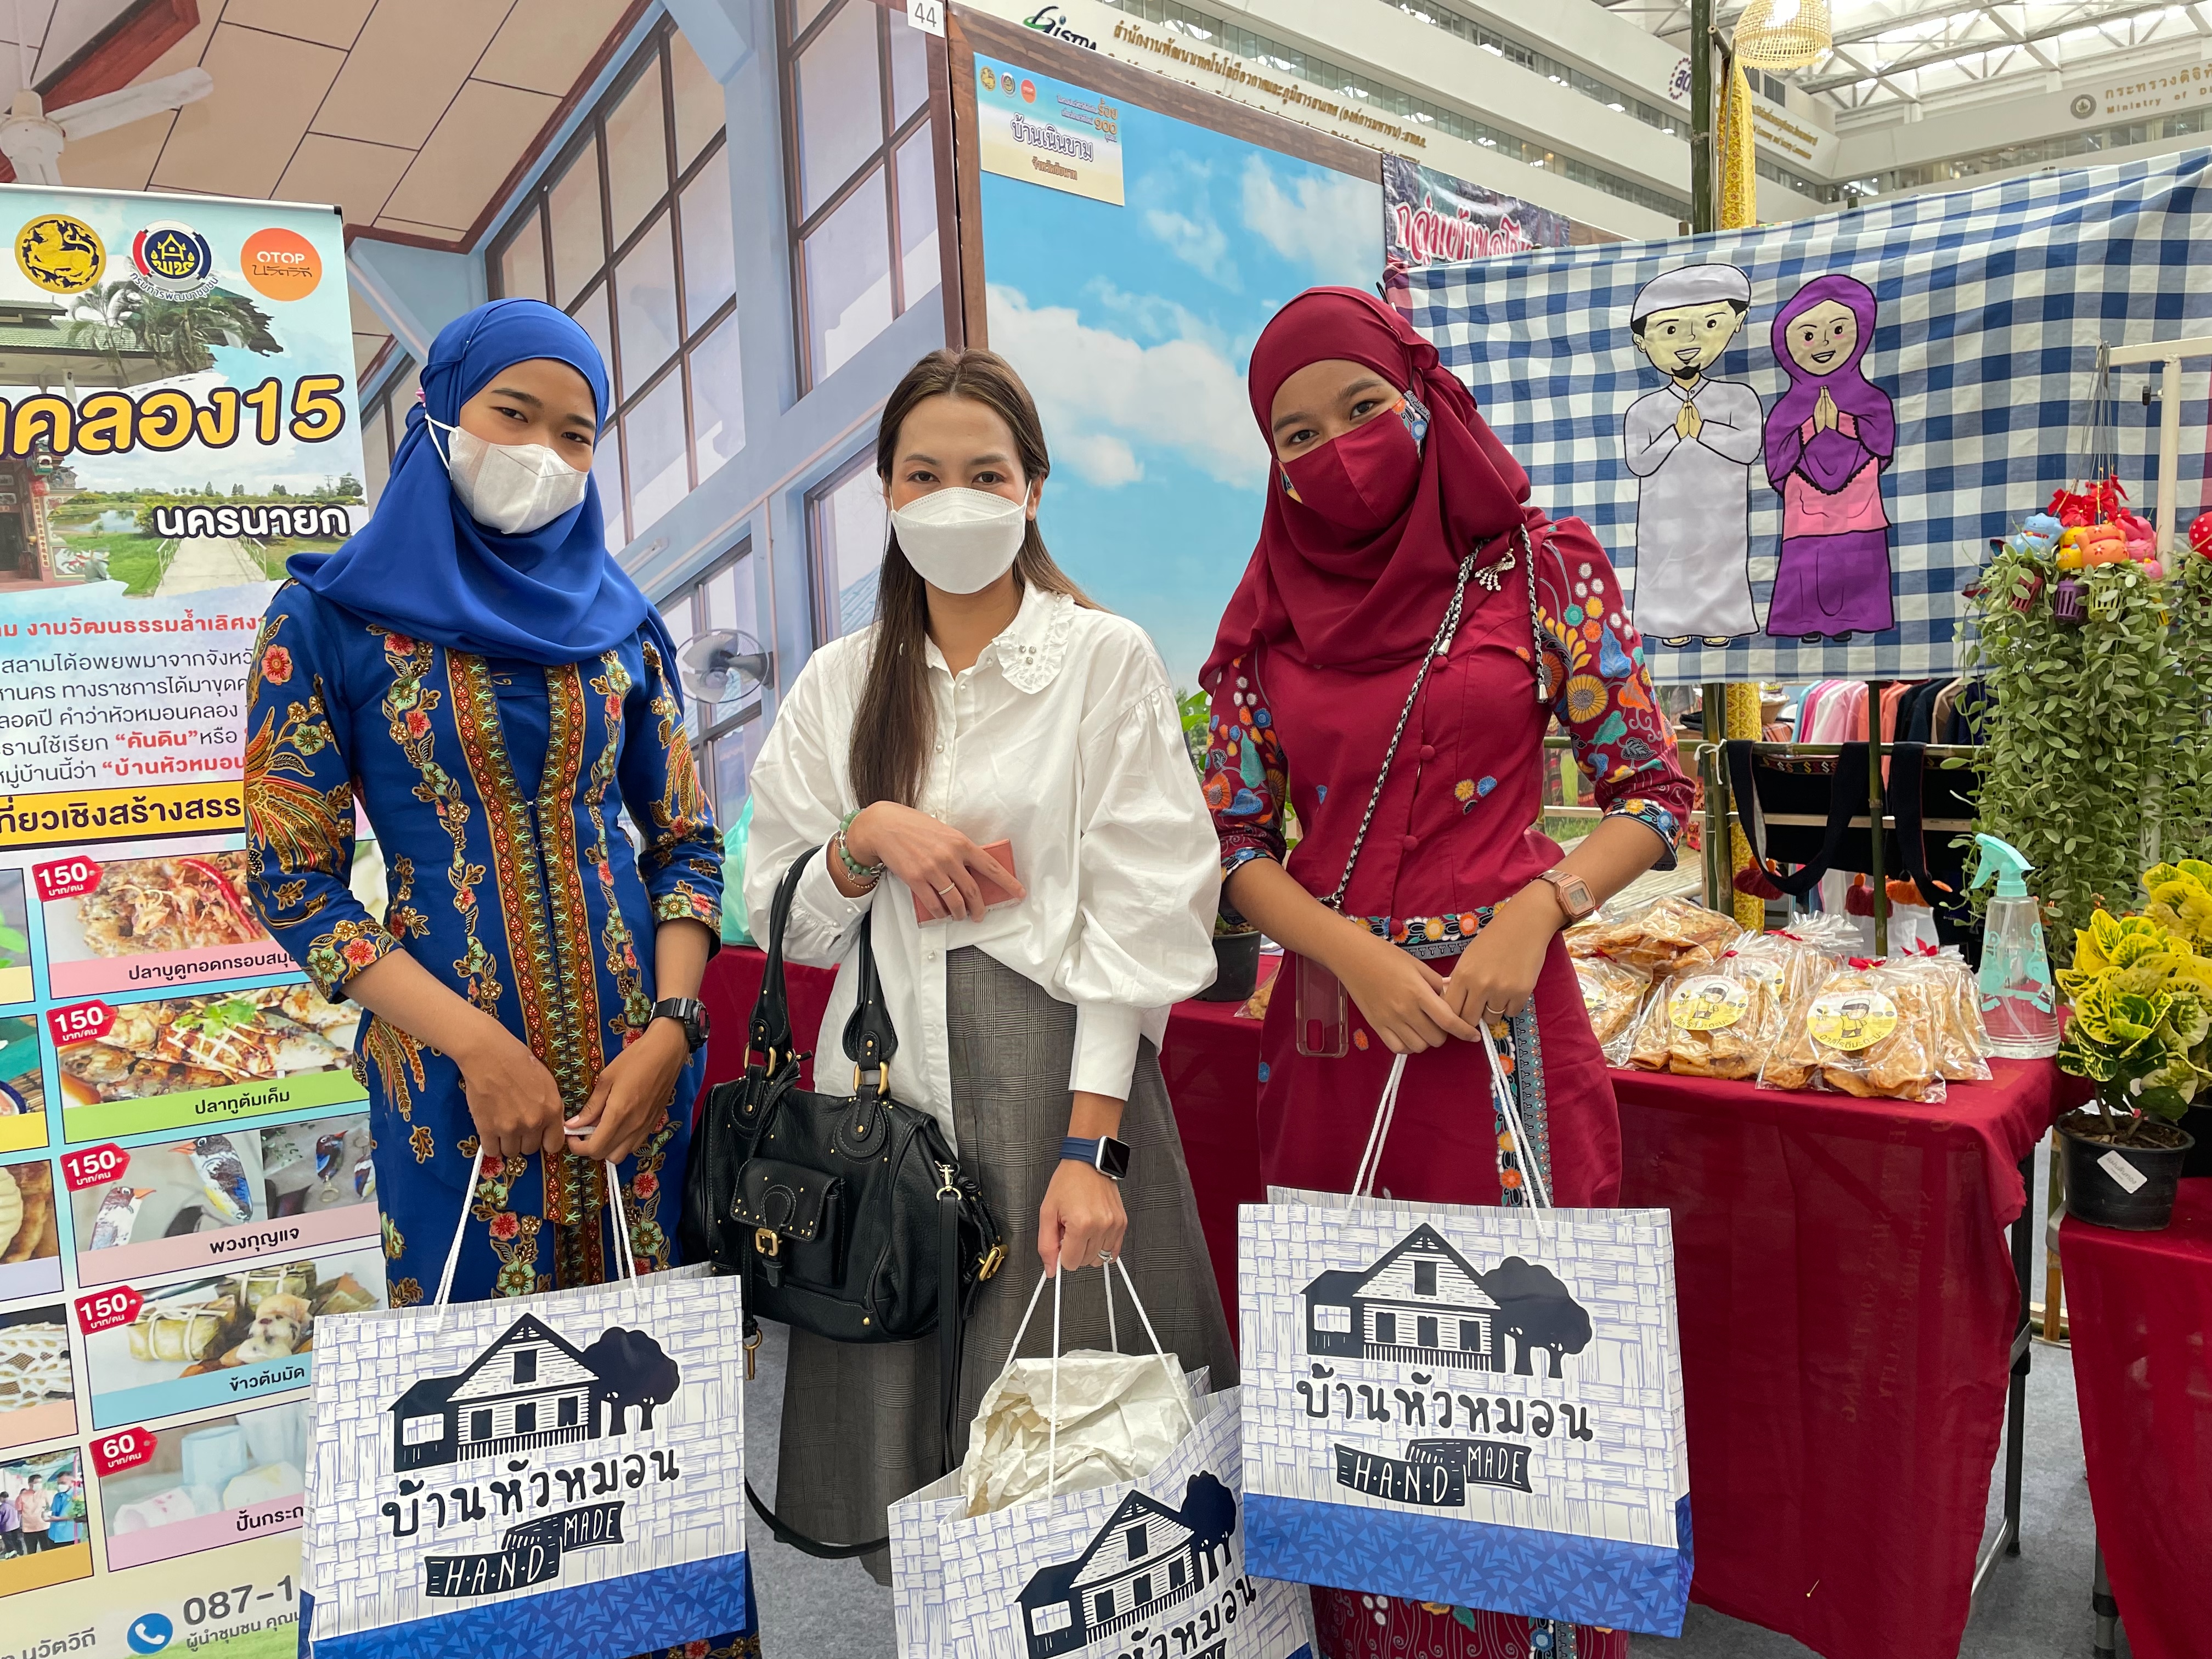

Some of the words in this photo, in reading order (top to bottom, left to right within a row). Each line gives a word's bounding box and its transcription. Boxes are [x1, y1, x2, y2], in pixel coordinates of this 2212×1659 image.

[915, 3, 937, 27] 44
[257, 251, 305, 264] OTOP
[129, 272, 219, 302] กรมการพัฒนาชุมชน
[154, 504, 349, 538] นครนายก
[0, 624, 18, 637] ม
[60, 705, 238, 725] คำว่าหัวหมอนคลอง
[38, 862, 88, 888] 150
[48, 884, 84, 896] บาท/คน
[55, 1007, 103, 1032] 150
[63, 1028, 98, 1041] บาท/คน
[195, 1087, 290, 1114] ปลาทูต้มเค็ม
[67, 1150, 116, 1177] 150
[76, 1171, 111, 1186] บาท/คน
[210, 1226, 300, 1255] พวงกุญแจ
[80, 1293, 127, 1321] 150
[91, 1314, 125, 1329] บาท/คน
[229, 1366, 305, 1392] ข้าวต้มมัด
[1296, 1363, 1593, 1442] บ้านหัวหมอน
[103, 1434, 136, 1458] 60
[108, 1451, 142, 1469] บาท/คน
[1468, 1445, 1523, 1485] MADE
[381, 1448, 679, 1538] บ้านหัวหมอน
[564, 1506, 616, 1547] MADE
[187, 1621, 261, 1652] ผู้นำชุมชน
